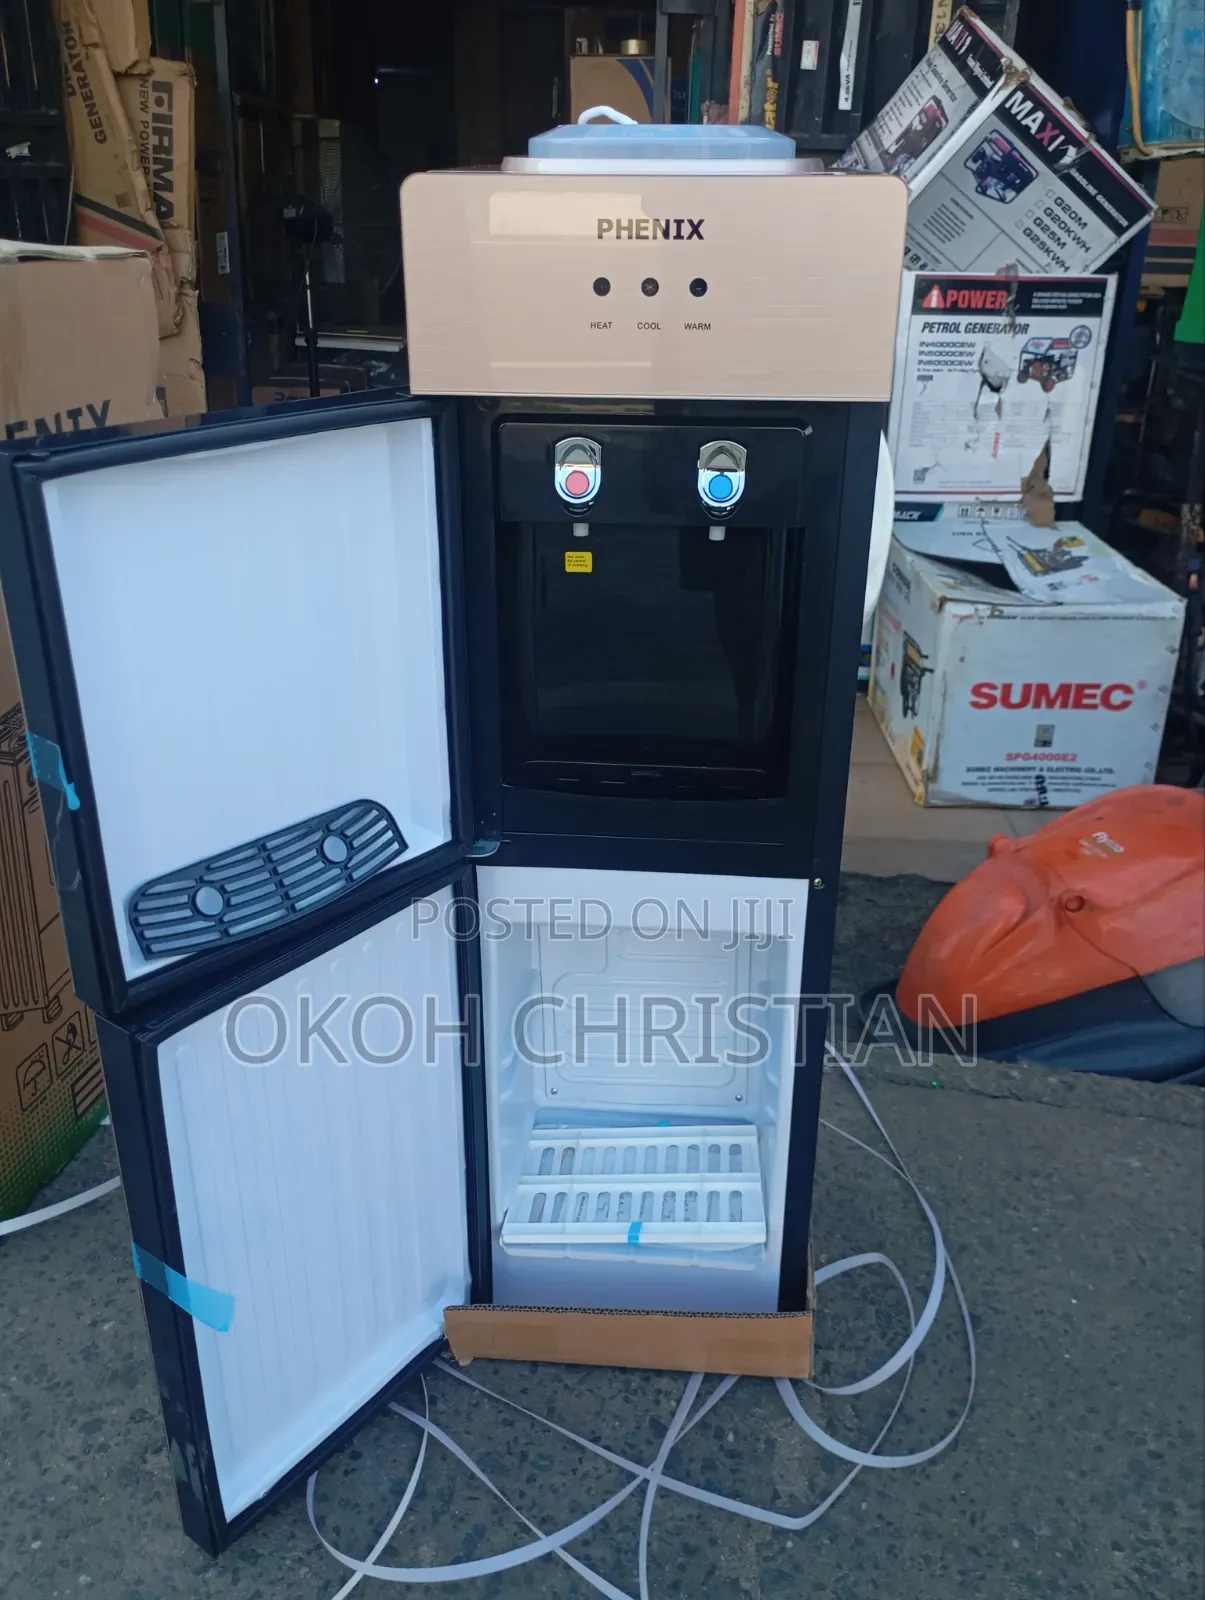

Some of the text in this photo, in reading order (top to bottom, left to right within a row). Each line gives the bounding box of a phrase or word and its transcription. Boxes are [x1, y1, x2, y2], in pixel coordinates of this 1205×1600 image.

[139, 78, 149, 112] NEW
[1004, 91, 1066, 152] MAXI
[597, 218, 705, 240] PHENIX
[1054, 196, 1088, 230] G20M
[1033, 216, 1068, 250] G25M
[1043, 206, 1092, 254] G20KWH
[1023, 227, 1071, 273] G25KWH
[590, 321, 613, 329] HEAT
[637, 322, 661, 330] COOL
[684, 322, 711, 330] WARM
[921, 322, 1030, 335] PETROL GENERATOR
[969, 682, 1135, 712] SUMEC
